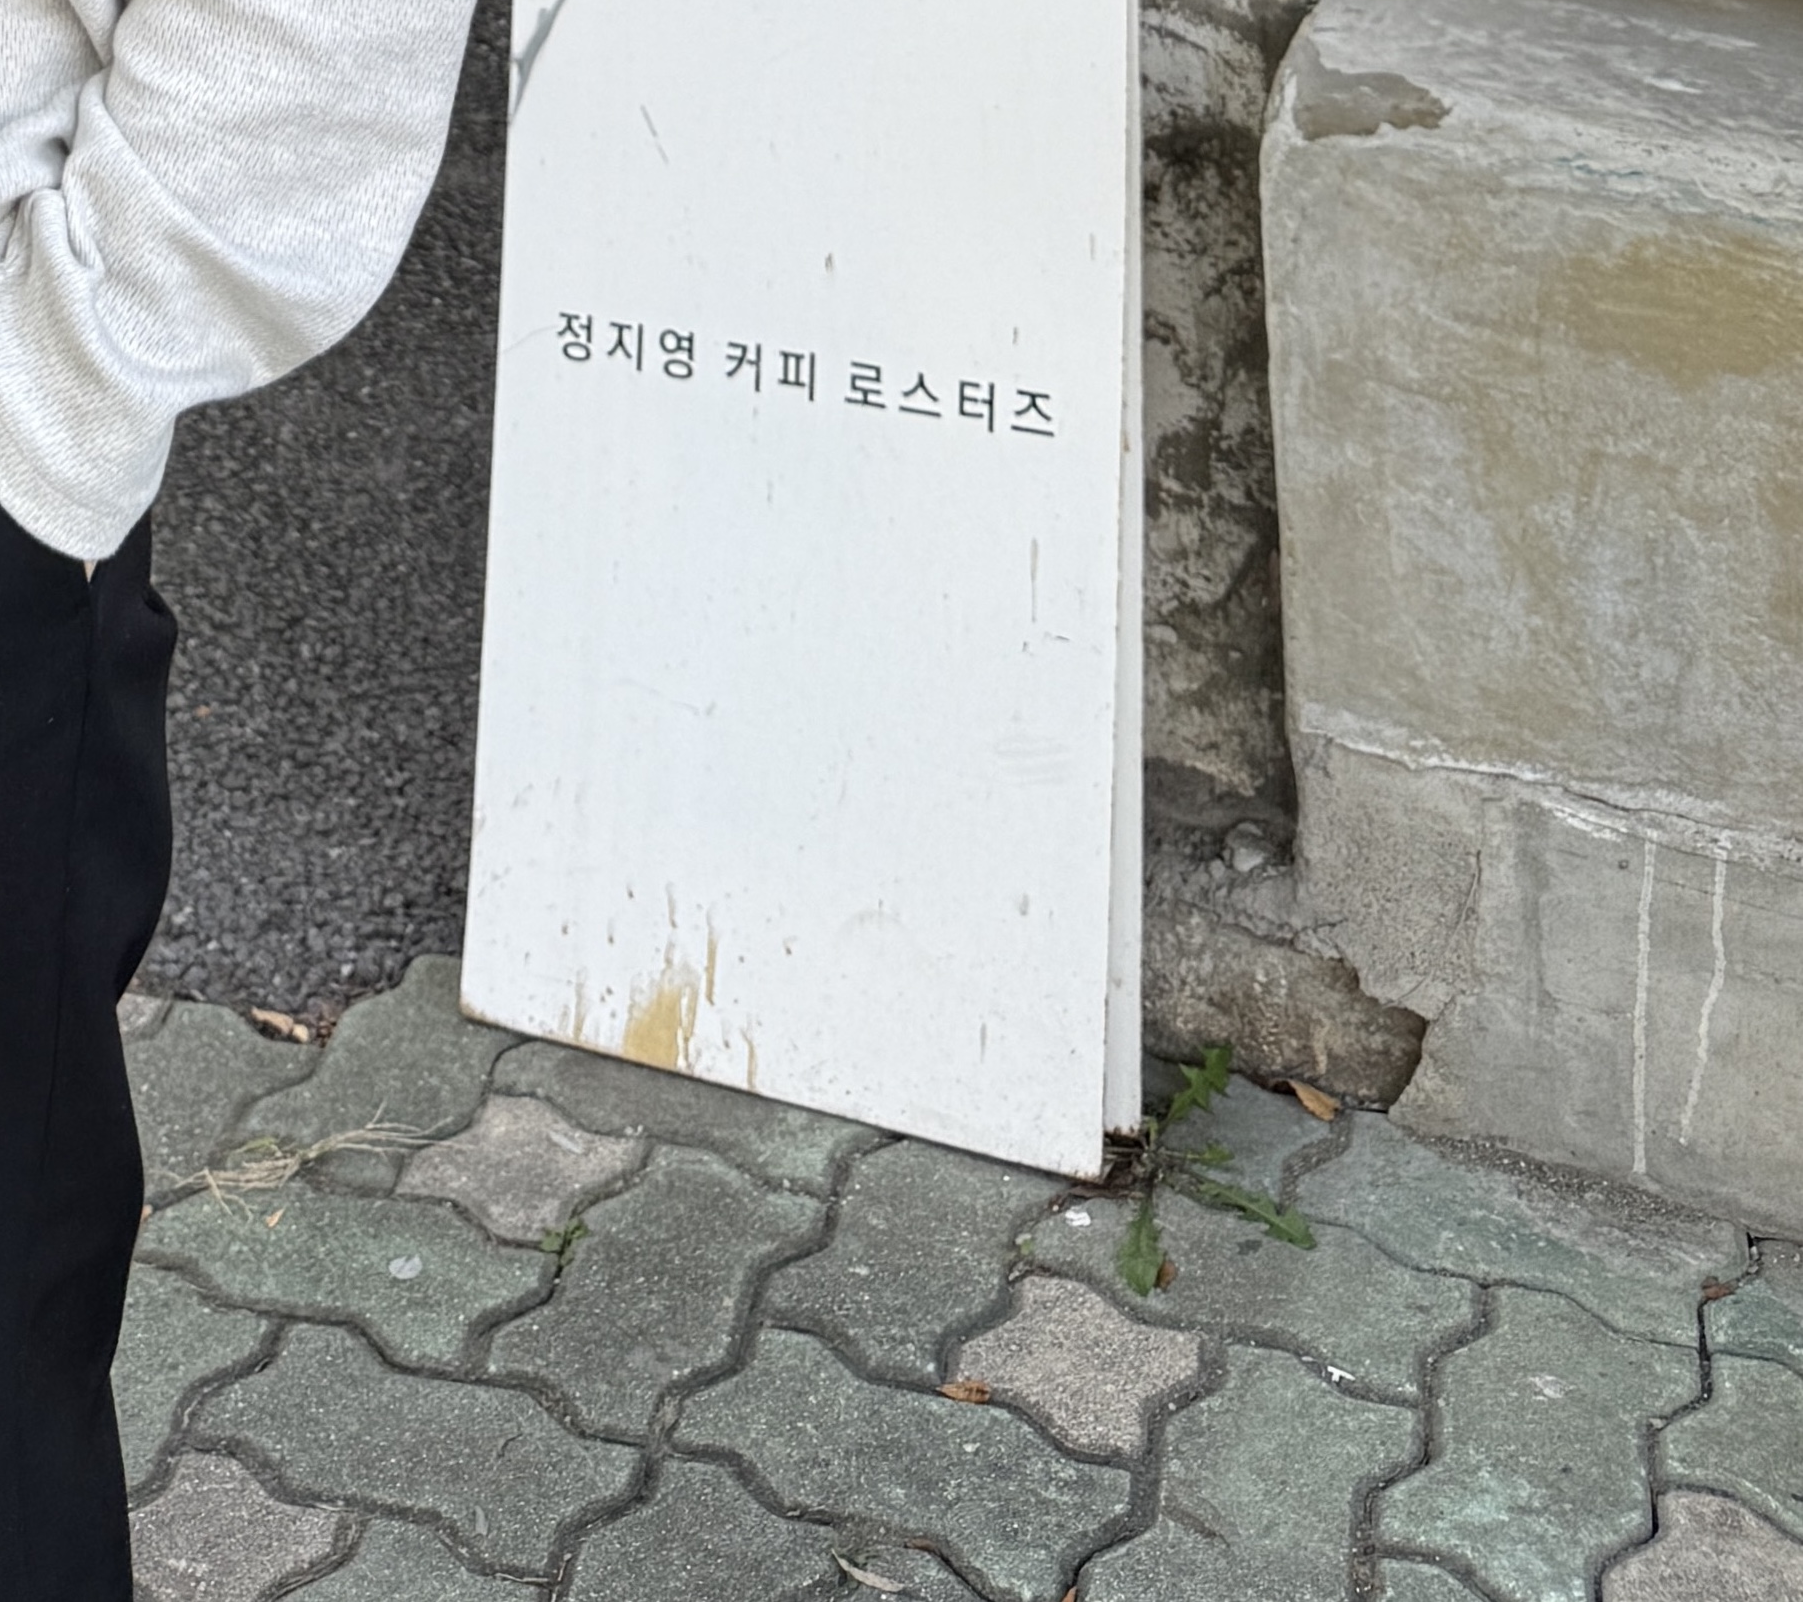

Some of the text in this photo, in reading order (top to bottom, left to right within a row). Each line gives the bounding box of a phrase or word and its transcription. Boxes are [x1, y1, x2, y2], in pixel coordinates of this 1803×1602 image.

[554, 311, 1057, 439] 정지영 커피 로스터즈
